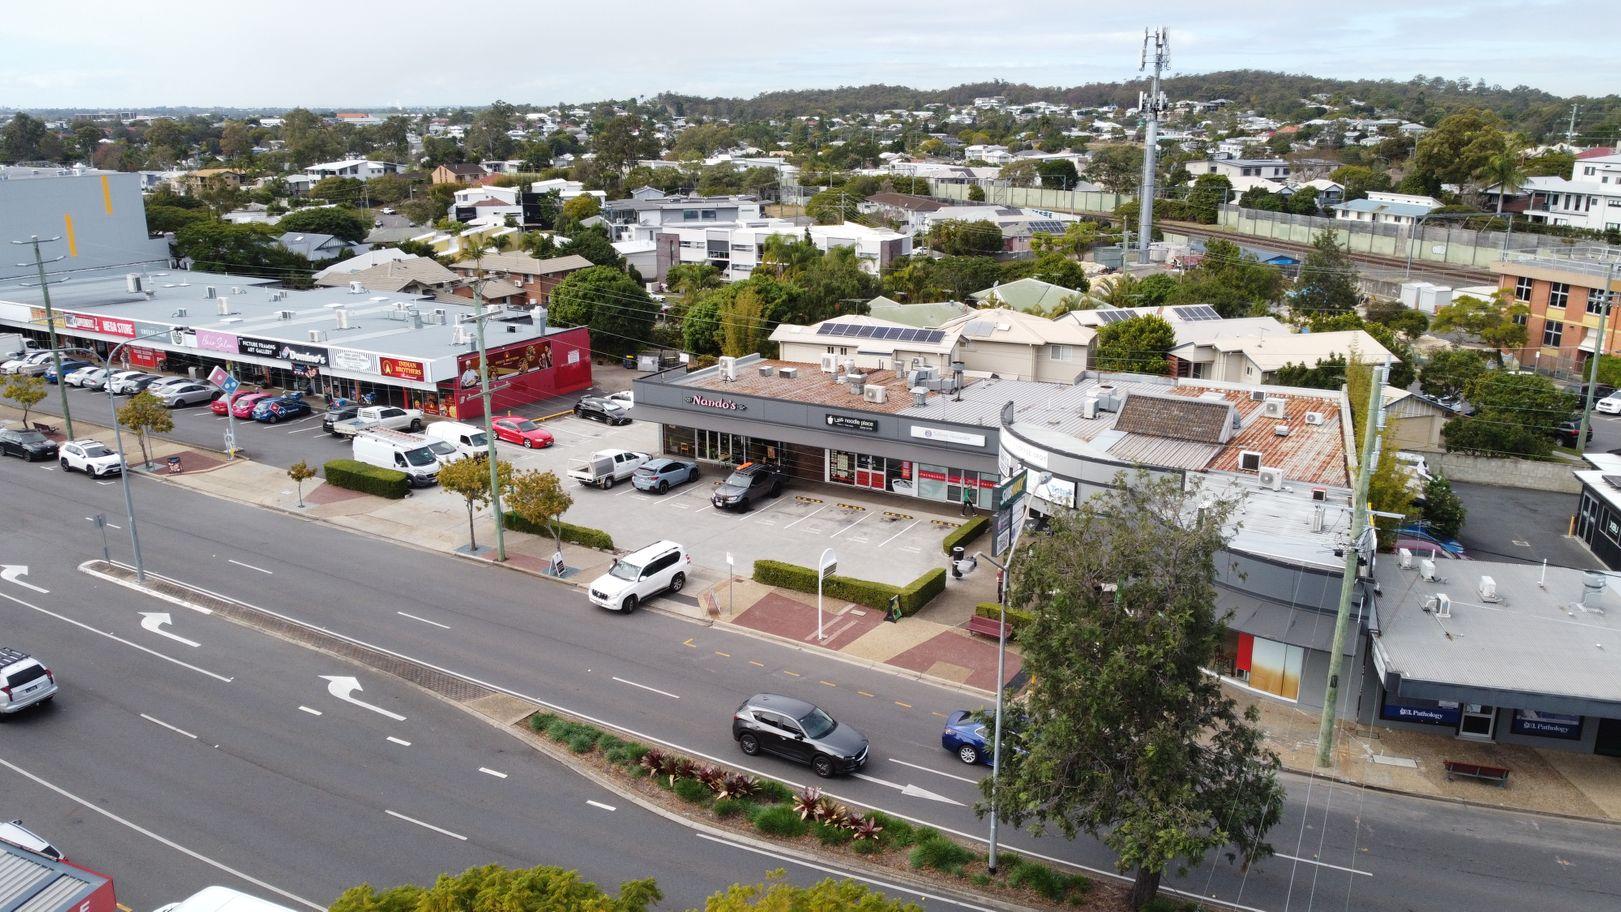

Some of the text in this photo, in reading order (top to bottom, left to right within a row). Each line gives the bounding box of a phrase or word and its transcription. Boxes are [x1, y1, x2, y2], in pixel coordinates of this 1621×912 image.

[102, 320, 117, 333] MEGA
[117, 322, 134, 335] STORE
[242, 340, 276, 350] PICTURE FRAMING
[289, 350, 326, 365] Domino's
[398, 360, 417, 368] INDIAN
[395, 366, 422, 376] BROTHERS
[692, 394, 737, 411] Nando's
[1413, 709, 1443, 720] Pathology
[1537, 723, 1568, 733] Pathology
